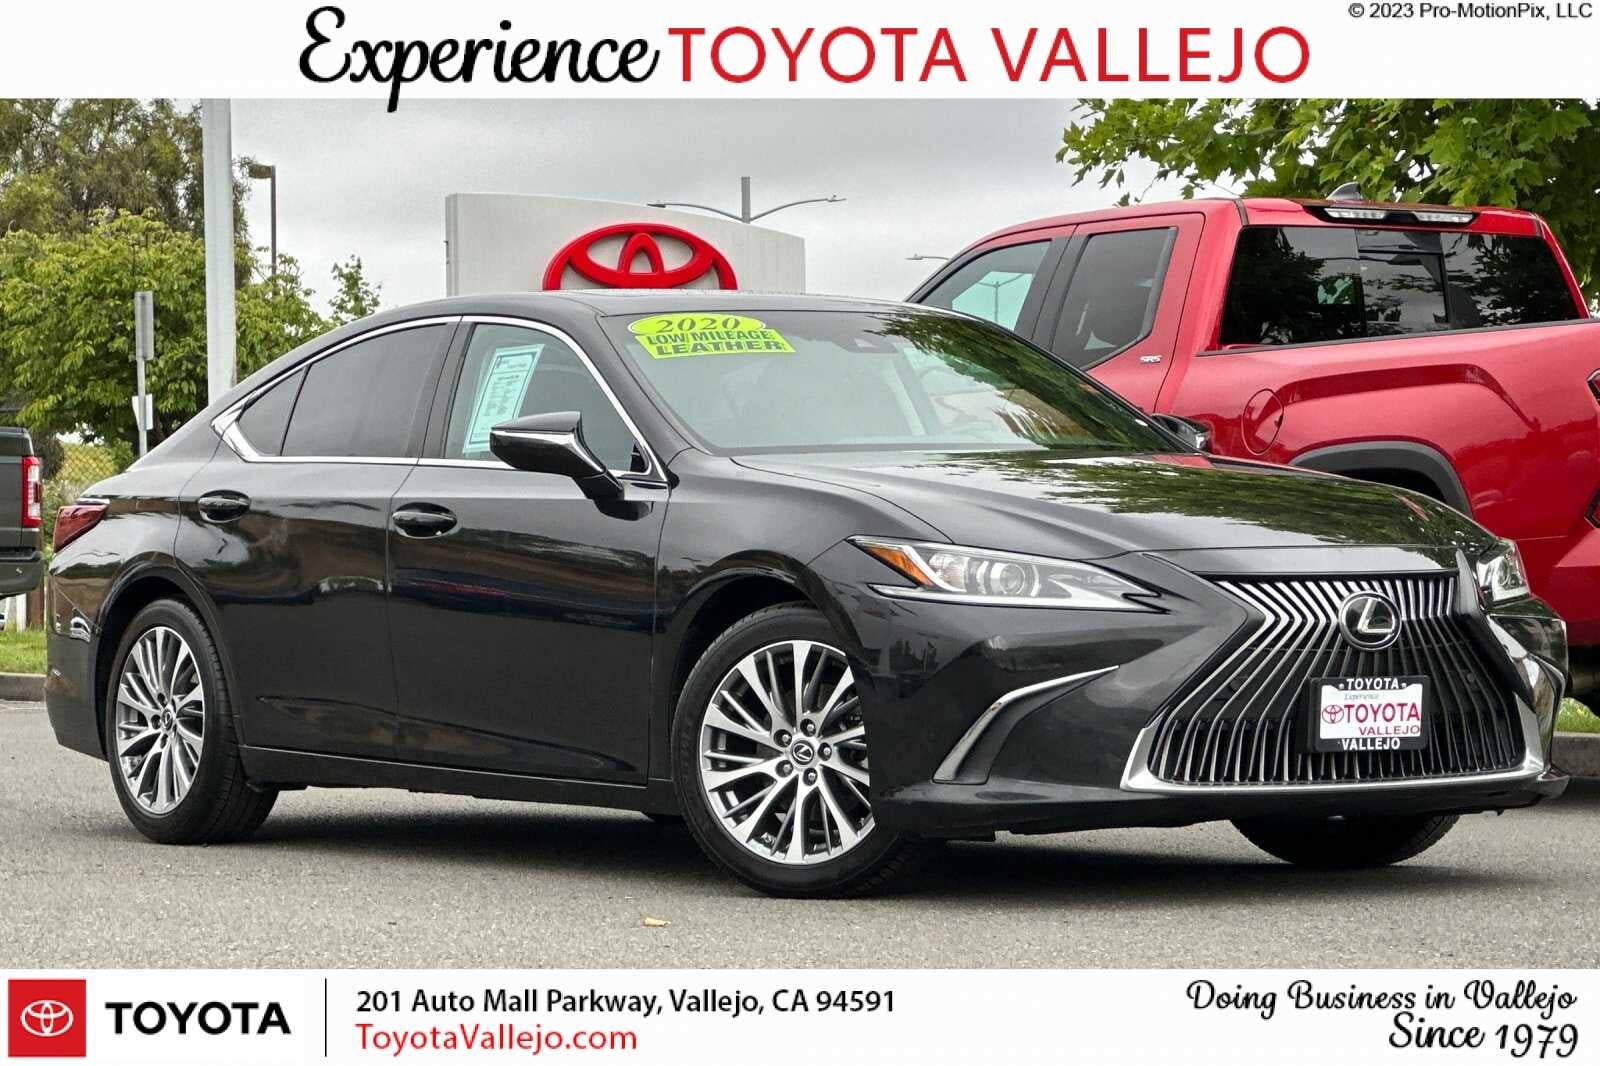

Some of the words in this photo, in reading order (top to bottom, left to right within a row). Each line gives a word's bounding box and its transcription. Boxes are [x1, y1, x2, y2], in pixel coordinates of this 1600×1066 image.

[656, 317, 741, 333] 2020
[646, 333, 686, 345] LOW
[693, 330, 774, 342] MILEAGE
[656, 339, 783, 355] LEATHER
[1346, 677, 1399, 690] TOYOTA
[1343, 702, 1421, 723] TOYOTA
[1358, 724, 1421, 736] VALLEJO
[1341, 737, 1401, 751] VALLEJO
